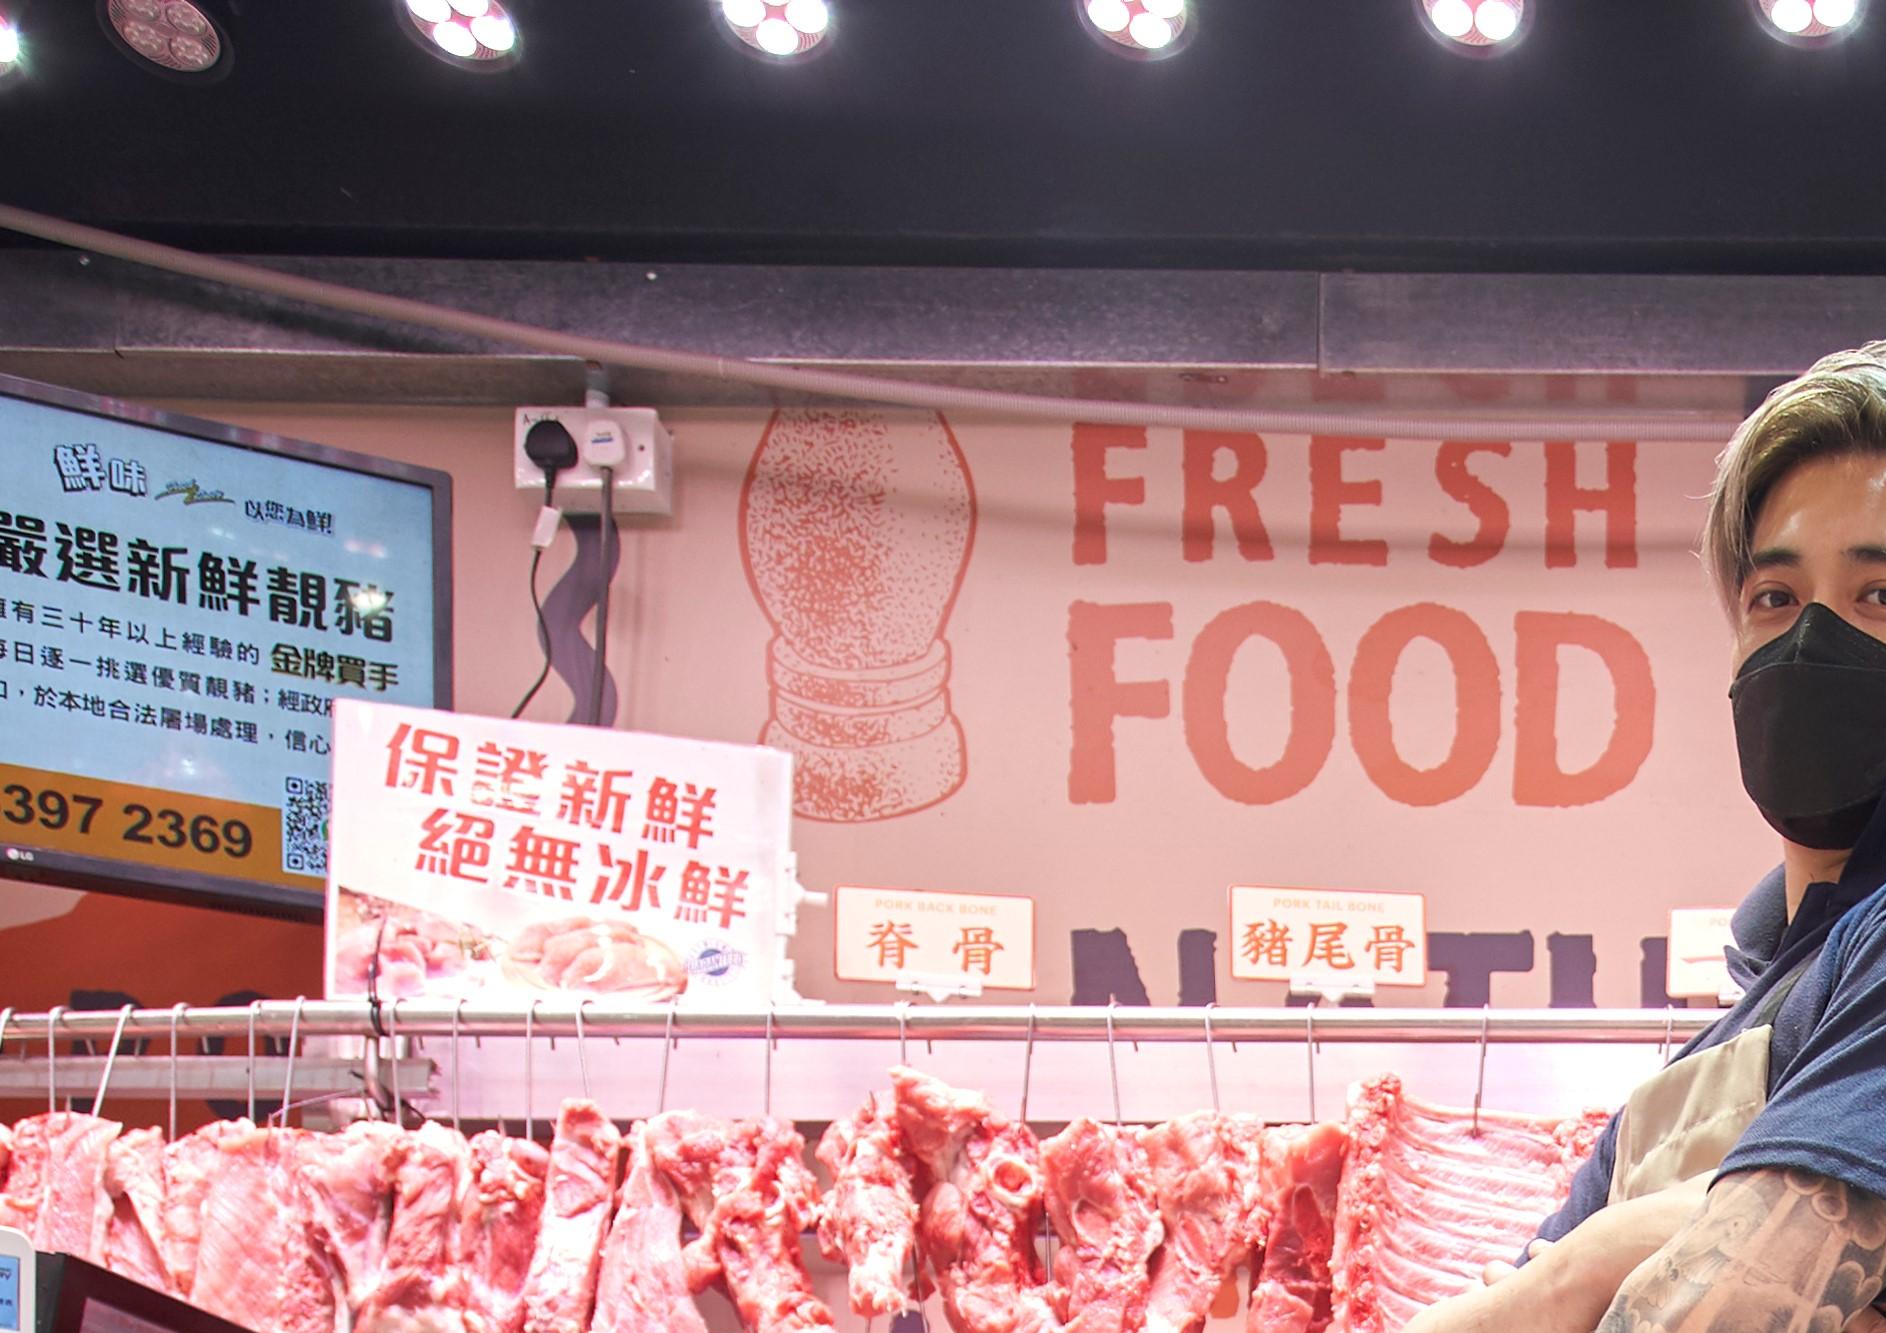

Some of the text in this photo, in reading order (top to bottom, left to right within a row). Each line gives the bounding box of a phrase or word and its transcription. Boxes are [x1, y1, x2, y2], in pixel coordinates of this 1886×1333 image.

[54, 444, 148, 497] 鮮味
[1070, 422, 1639, 568] FRESH
[270, 642, 400, 692] 金牌買手
[1066, 600, 1656, 808] FOOD
[384, 722, 719, 851] 保證新鮮
[3, 784, 253, 859] 397 2369
[414, 806, 751, 930] 絕無冰鮮
[875, 898, 998, 916] PORK BACK BONE
[1273, 897, 1385, 913] PORK TAIL BONE
[866, 920, 1005, 975] 脊骨
[1241, 918, 1416, 973] 豬尾骨
